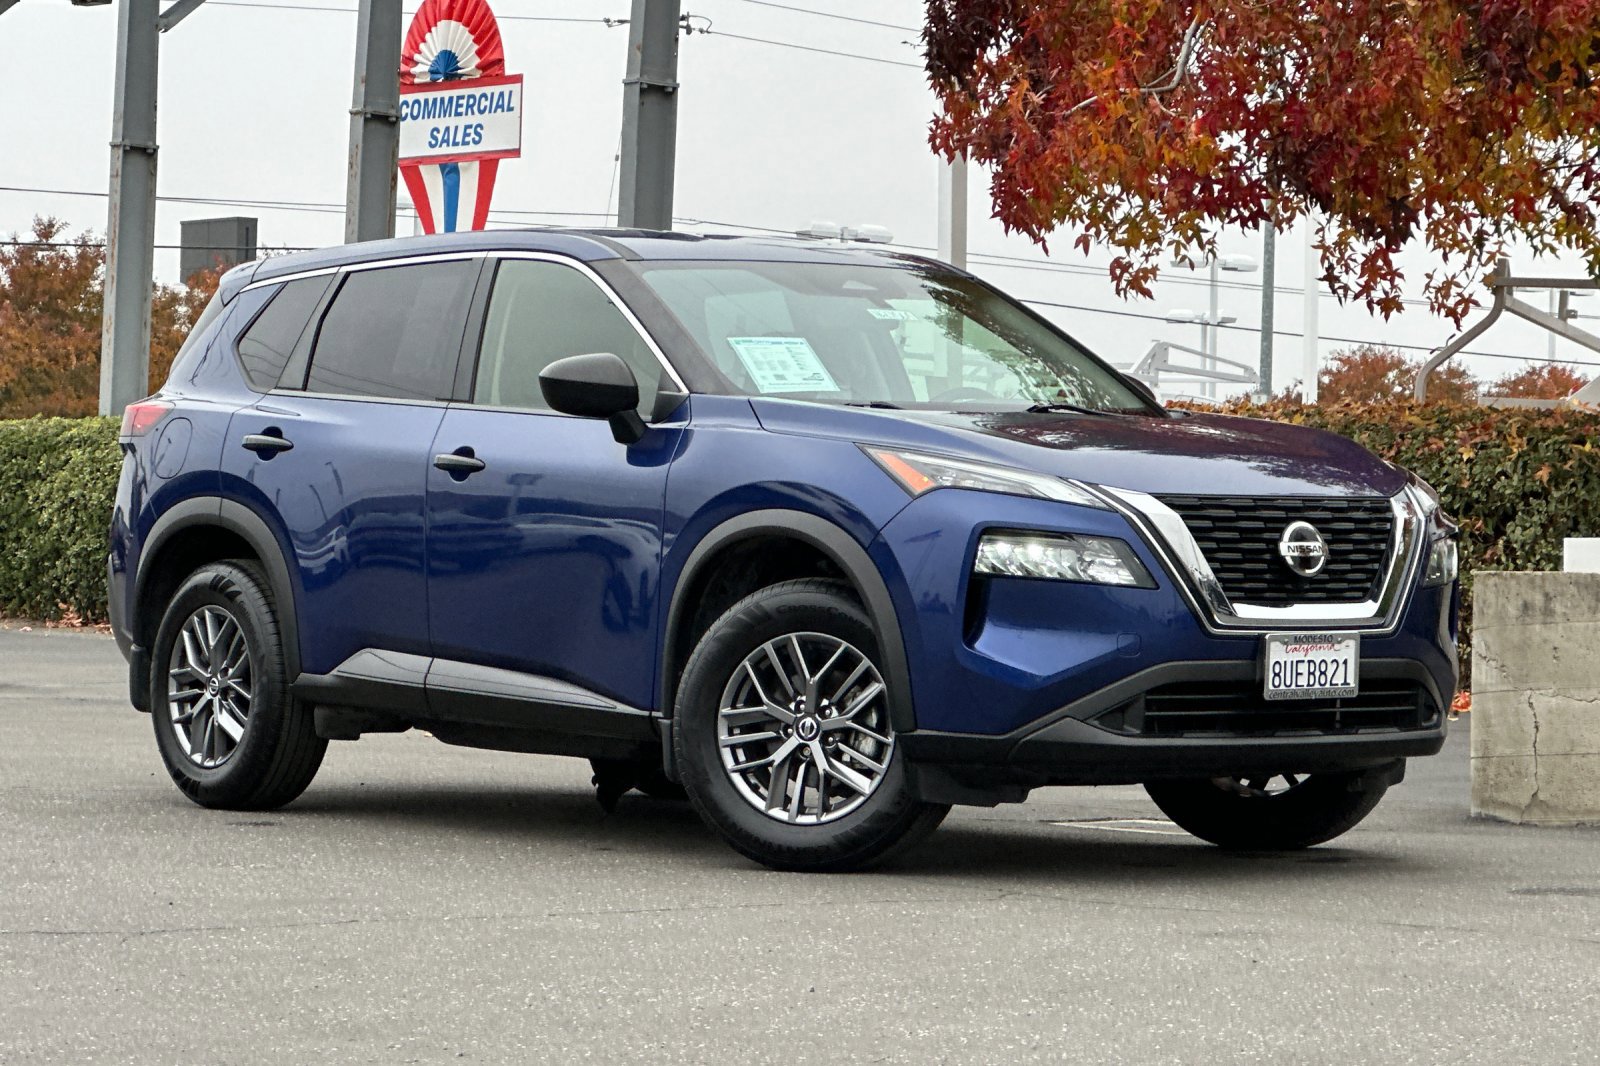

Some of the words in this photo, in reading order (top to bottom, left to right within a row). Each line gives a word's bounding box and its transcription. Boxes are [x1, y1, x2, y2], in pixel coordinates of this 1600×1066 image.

[400, 90, 515, 122] COMMERCIAL
[428, 123, 485, 149] SALES
[1285, 643, 1341, 657] California
[1293, 634, 1334, 644] MODESTO
[1271, 658, 1351, 689] 8UEB821
